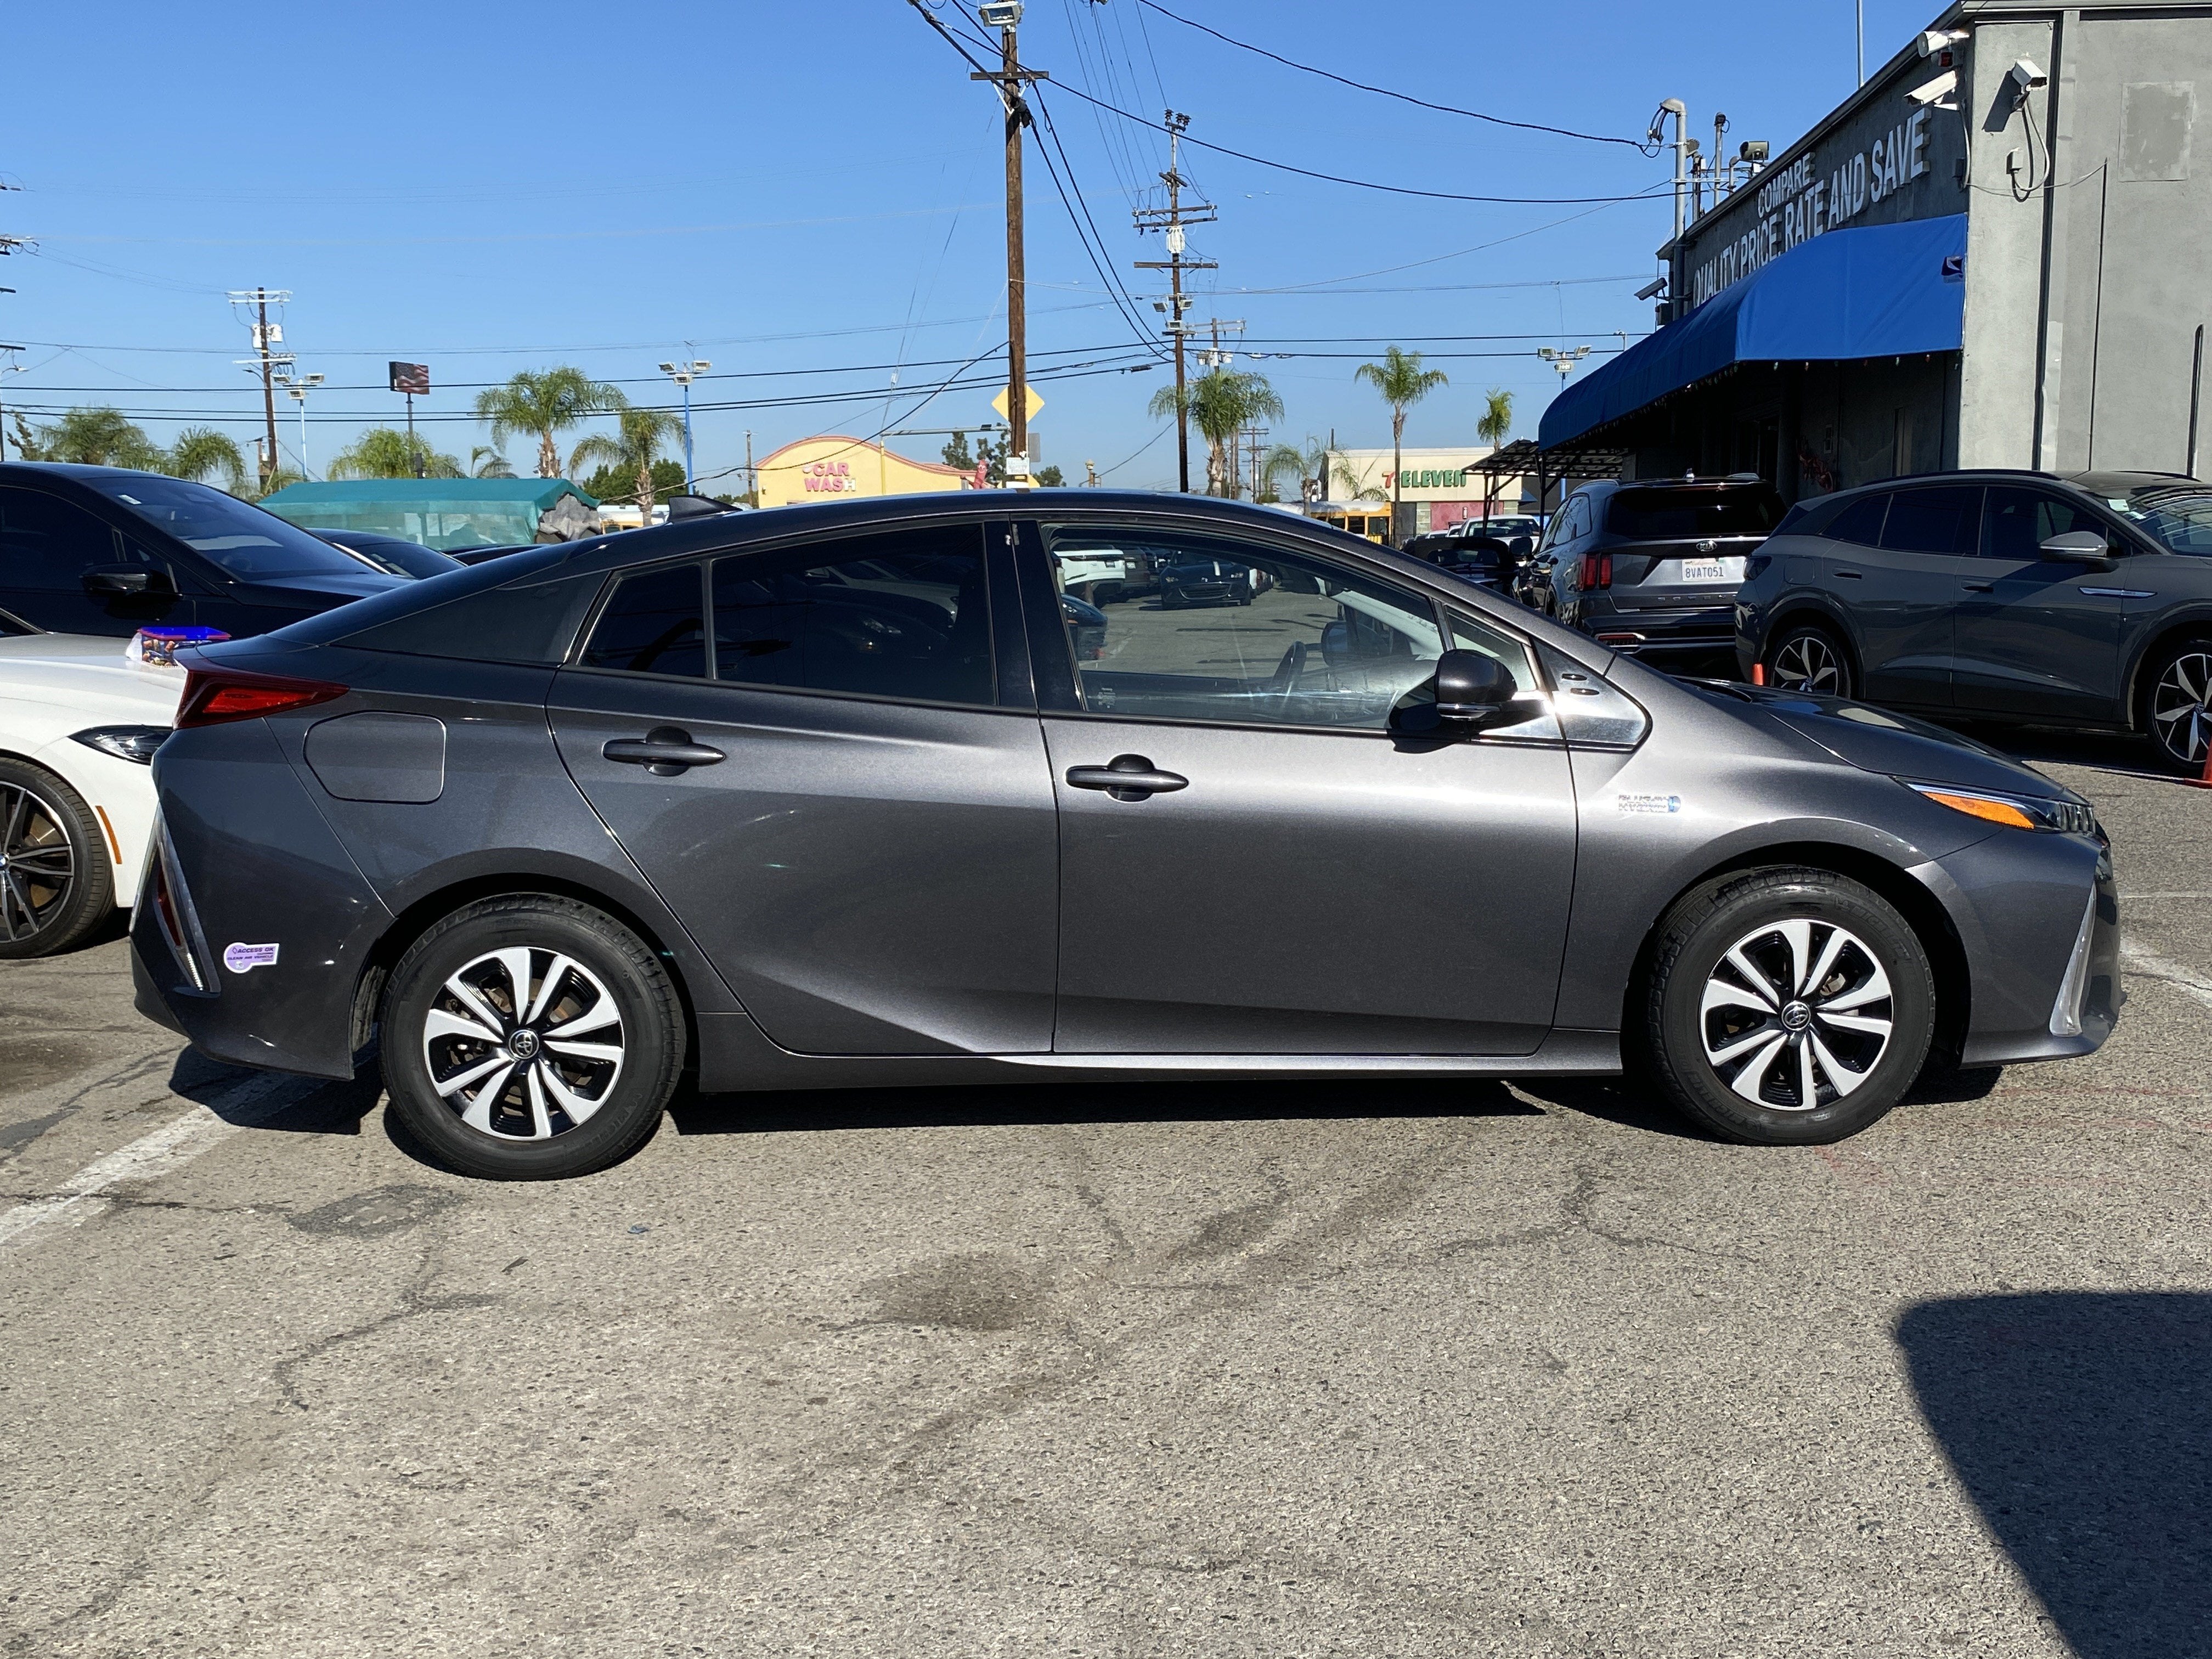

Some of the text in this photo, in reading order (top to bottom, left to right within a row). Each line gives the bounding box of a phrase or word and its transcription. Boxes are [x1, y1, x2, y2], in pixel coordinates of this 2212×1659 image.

[1758, 152, 1812, 218] COMPARE
[1785, 179, 1825, 252] RATE
[1827, 153, 1865, 230] AND
[1871, 108, 1928, 203] SAVE
[813, 462, 850, 477] CAR
[804, 477, 856, 492] WASH
[1685, 566, 1724, 578] 8VAT051
